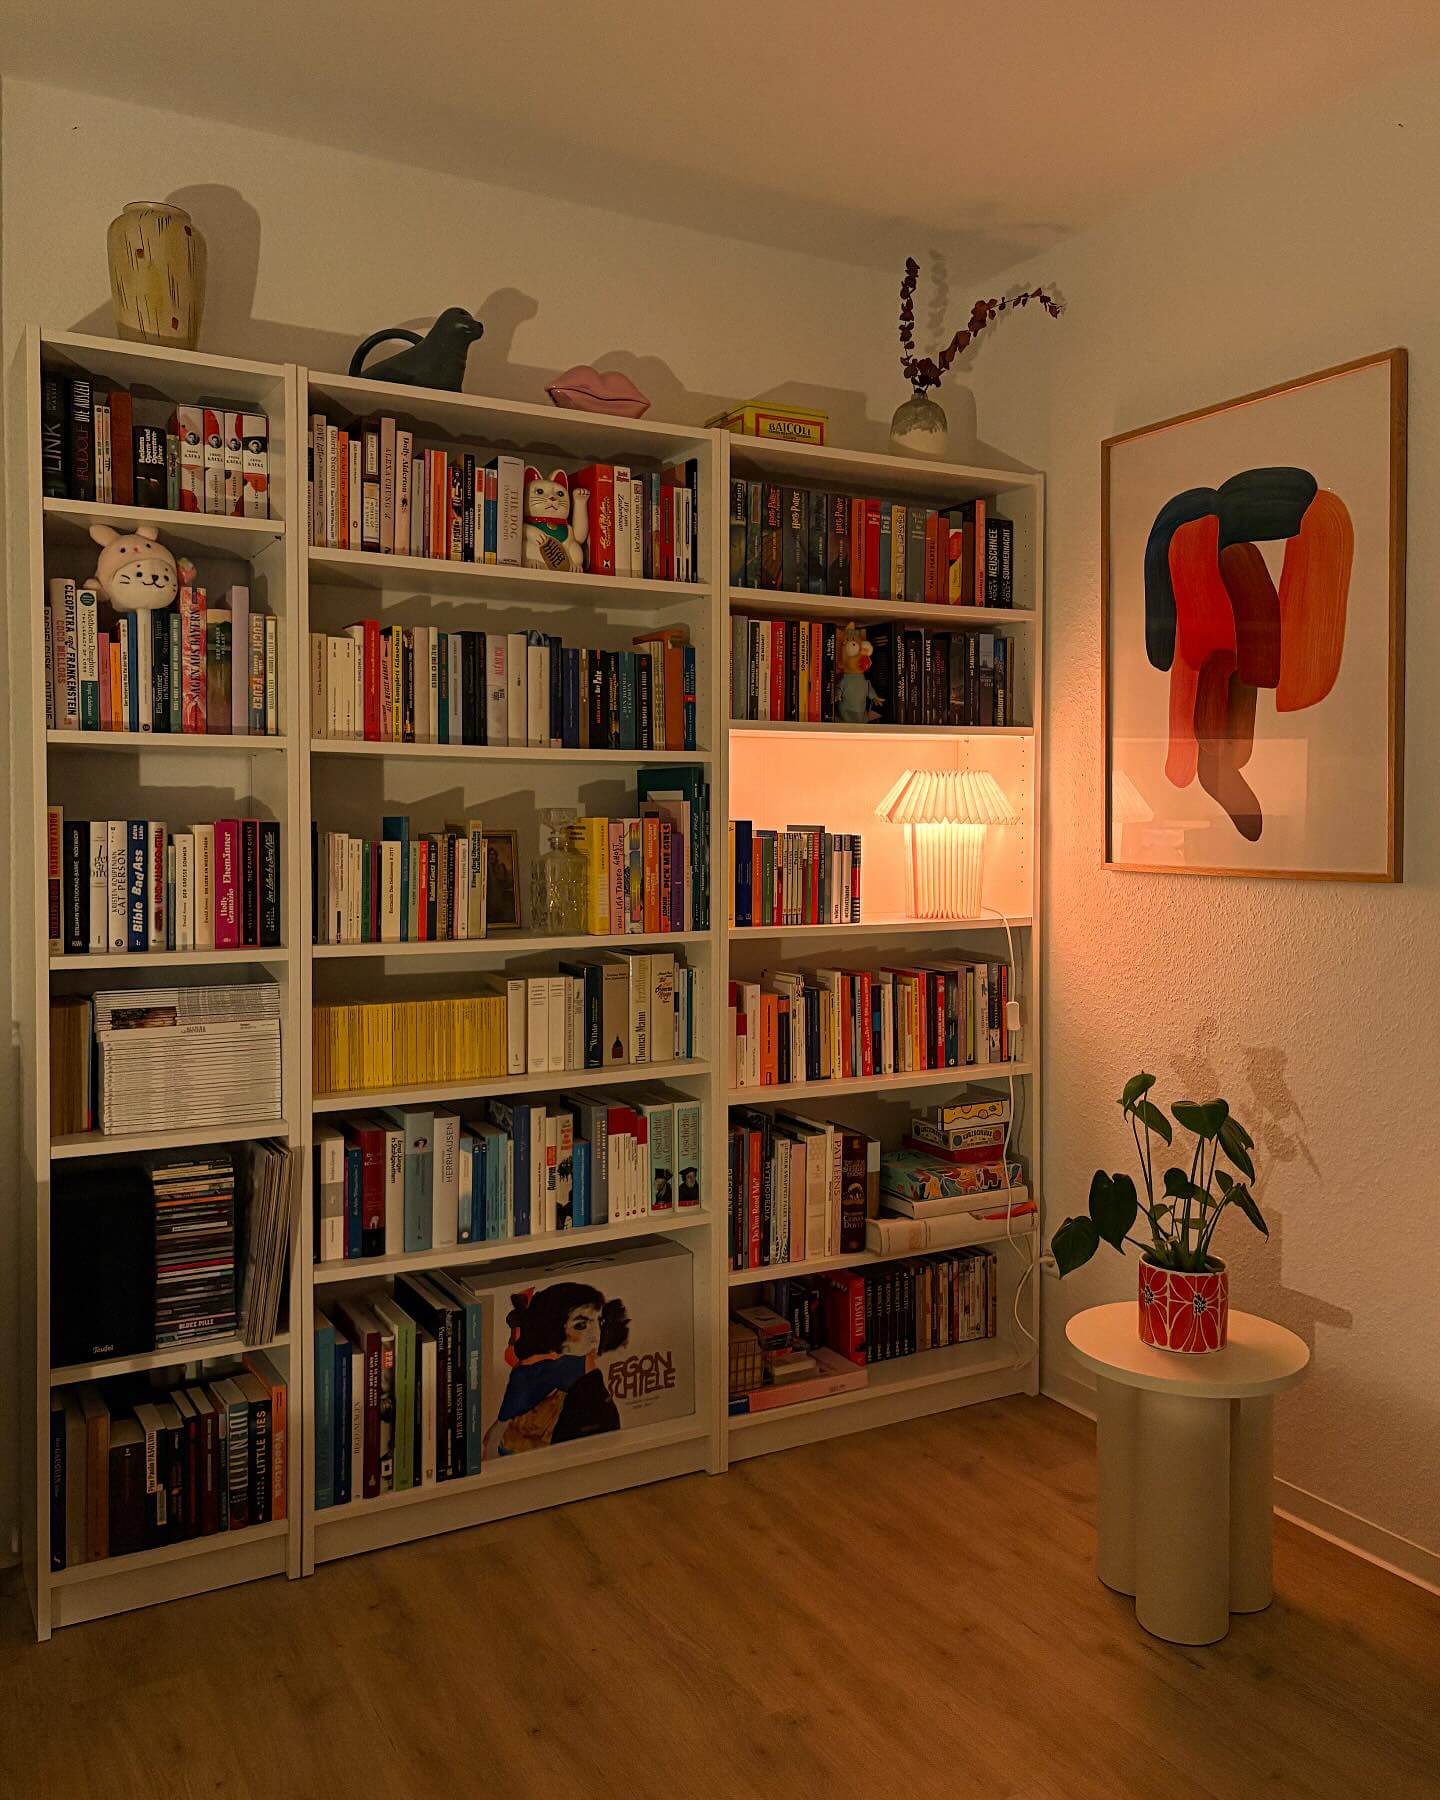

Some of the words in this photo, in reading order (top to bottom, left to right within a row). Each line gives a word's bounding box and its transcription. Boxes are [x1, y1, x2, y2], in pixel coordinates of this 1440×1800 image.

[330, 430, 339, 454] Gloria
[769, 422, 811, 436] BAICOLI
[43, 423, 63, 472] LINK
[400, 437, 409, 456] Dolly
[330, 457, 338, 489] Steinem
[401, 458, 409, 493] Alderton
[509, 490, 519, 512] THE
[791, 490, 801, 511] Potter
[509, 515, 519, 539] DOG
[791, 511, 801, 529] Harry
[988, 528, 998, 577] NEUSCHNEE
[1002, 528, 1010, 580] SOMMERNACHT
[64, 584, 74, 632] CLEOPATRA
[56, 620, 65, 642] COCO
[87, 609, 96, 644] Motherless
[190, 609, 200, 646] BAYERN
[253, 616, 263, 652] LEUCHT
[57, 645, 66, 684] MELLORS
[86, 645, 96, 677] Daughters
[190, 647, 200, 666] AUS
[66, 652, 77, 716] FRANKENSTEIN
[190, 667, 200, 700] SAGEN
[253, 677, 263, 710] FEUER
[394, 669, 402, 704] Komplett
[118, 849, 126, 890] PERSON
[222, 831, 232, 884] Ehemänner
[612, 843, 620, 865] GHOST
[663, 852, 670, 865] ME
[615, 869, 623, 894] TADDEO
[118, 895, 126, 916] CAT
[132, 901, 144, 933] Bible
[220, 896, 228, 916] Holly
[227, 888, 235, 923] Gramazio
[615, 896, 623, 909] LISA
[590, 1023, 598, 1046] Wilde
[634, 1011, 646, 1032] Mann
[634, 1033, 646, 1063] Thomas
[653, 1117, 663, 1161] Geschichte
[681, 1113, 690, 1157] Geschichte
[445, 1122, 454, 1183] HERRHAUSEN
[833, 1139, 841, 1196] PATTERNS
[752, 1177, 760, 1194] Me?
[751, 1194, 760, 1215] Read
[752, 1215, 760, 1230] You
[752, 1230, 760, 1242] Do
[854, 1295, 865, 1337] PASOLINI
[608, 1351, 672, 1378] EGON
[256, 1410, 265, 1435] LIES
[256, 1439, 265, 1474] LITTLE
[274, 1430, 283, 1498] Woodstock
